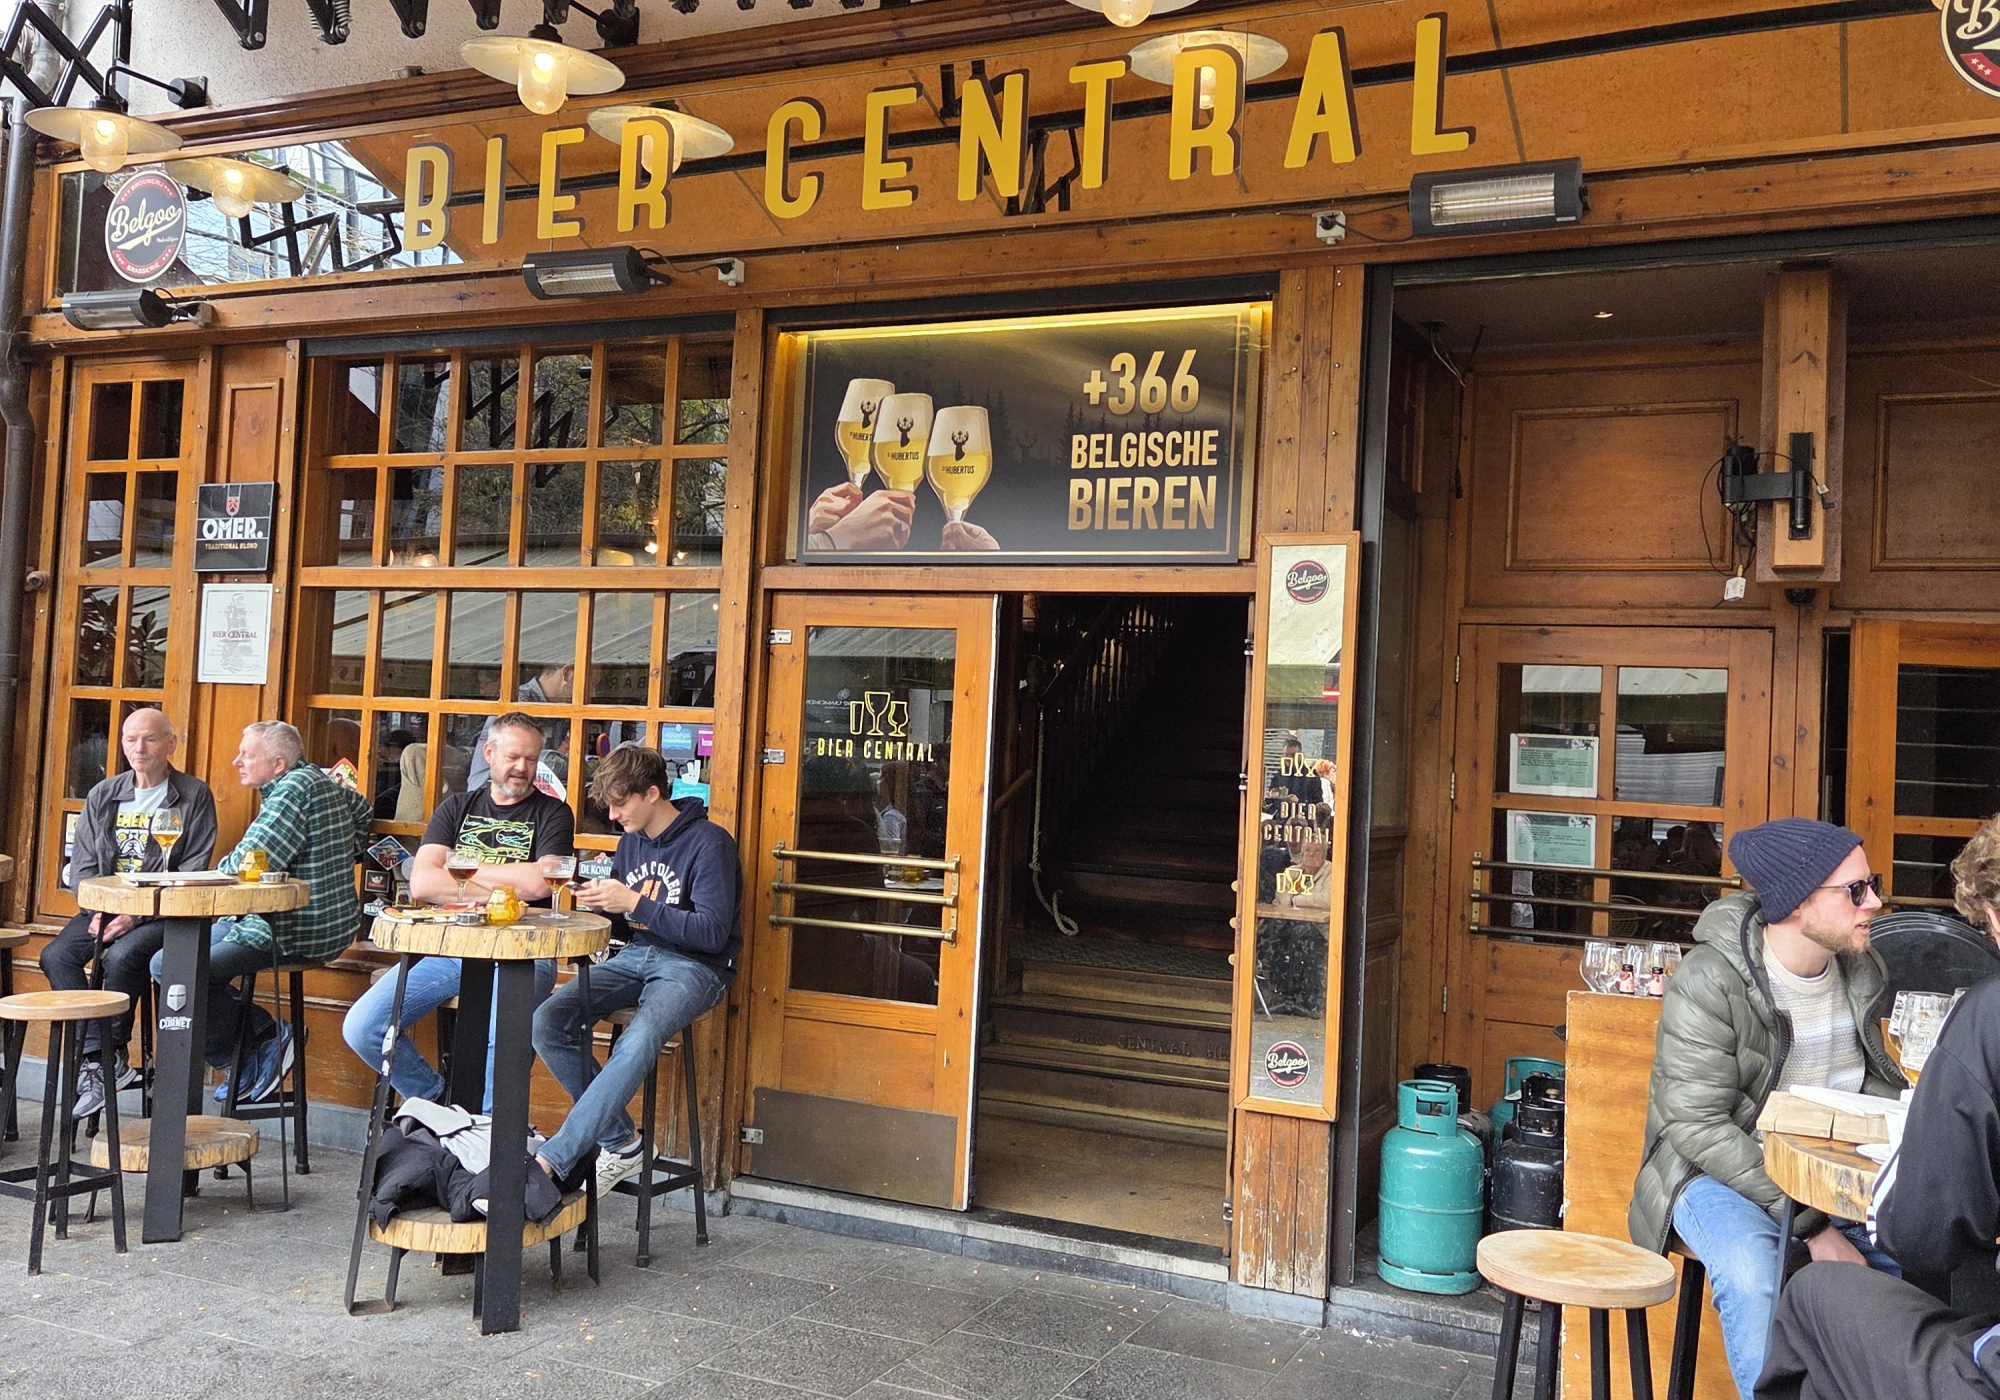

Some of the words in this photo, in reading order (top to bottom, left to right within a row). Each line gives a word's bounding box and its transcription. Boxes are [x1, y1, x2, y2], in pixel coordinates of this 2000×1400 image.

[403, 116, 671, 251] BIER
[764, 16, 1474, 219] CENTRAL
[110, 197, 182, 249] Belgoo
[1083, 349, 1199, 415] +366
[890, 451, 919, 461] HUBERTUS
[1071, 430, 1219, 469] BELGISCHE
[945, 465, 975, 475] HUBERTUS
[1068, 475, 1217, 530] BIEREN
[205, 542, 239, 550] TRADITIONAL
[1287, 569, 1327, 591] Belgoo
[227, 631, 258, 639] CENTRAL
[817, 737, 854, 758] BIER
[863, 740, 934, 762] CENTRAL
[1280, 801, 1317, 820] BIER
[1263, 824, 1332, 845] CENTRAL
[159, 1017, 192, 1030] CORNET
[1267, 1052, 1308, 1074] Belgoo
